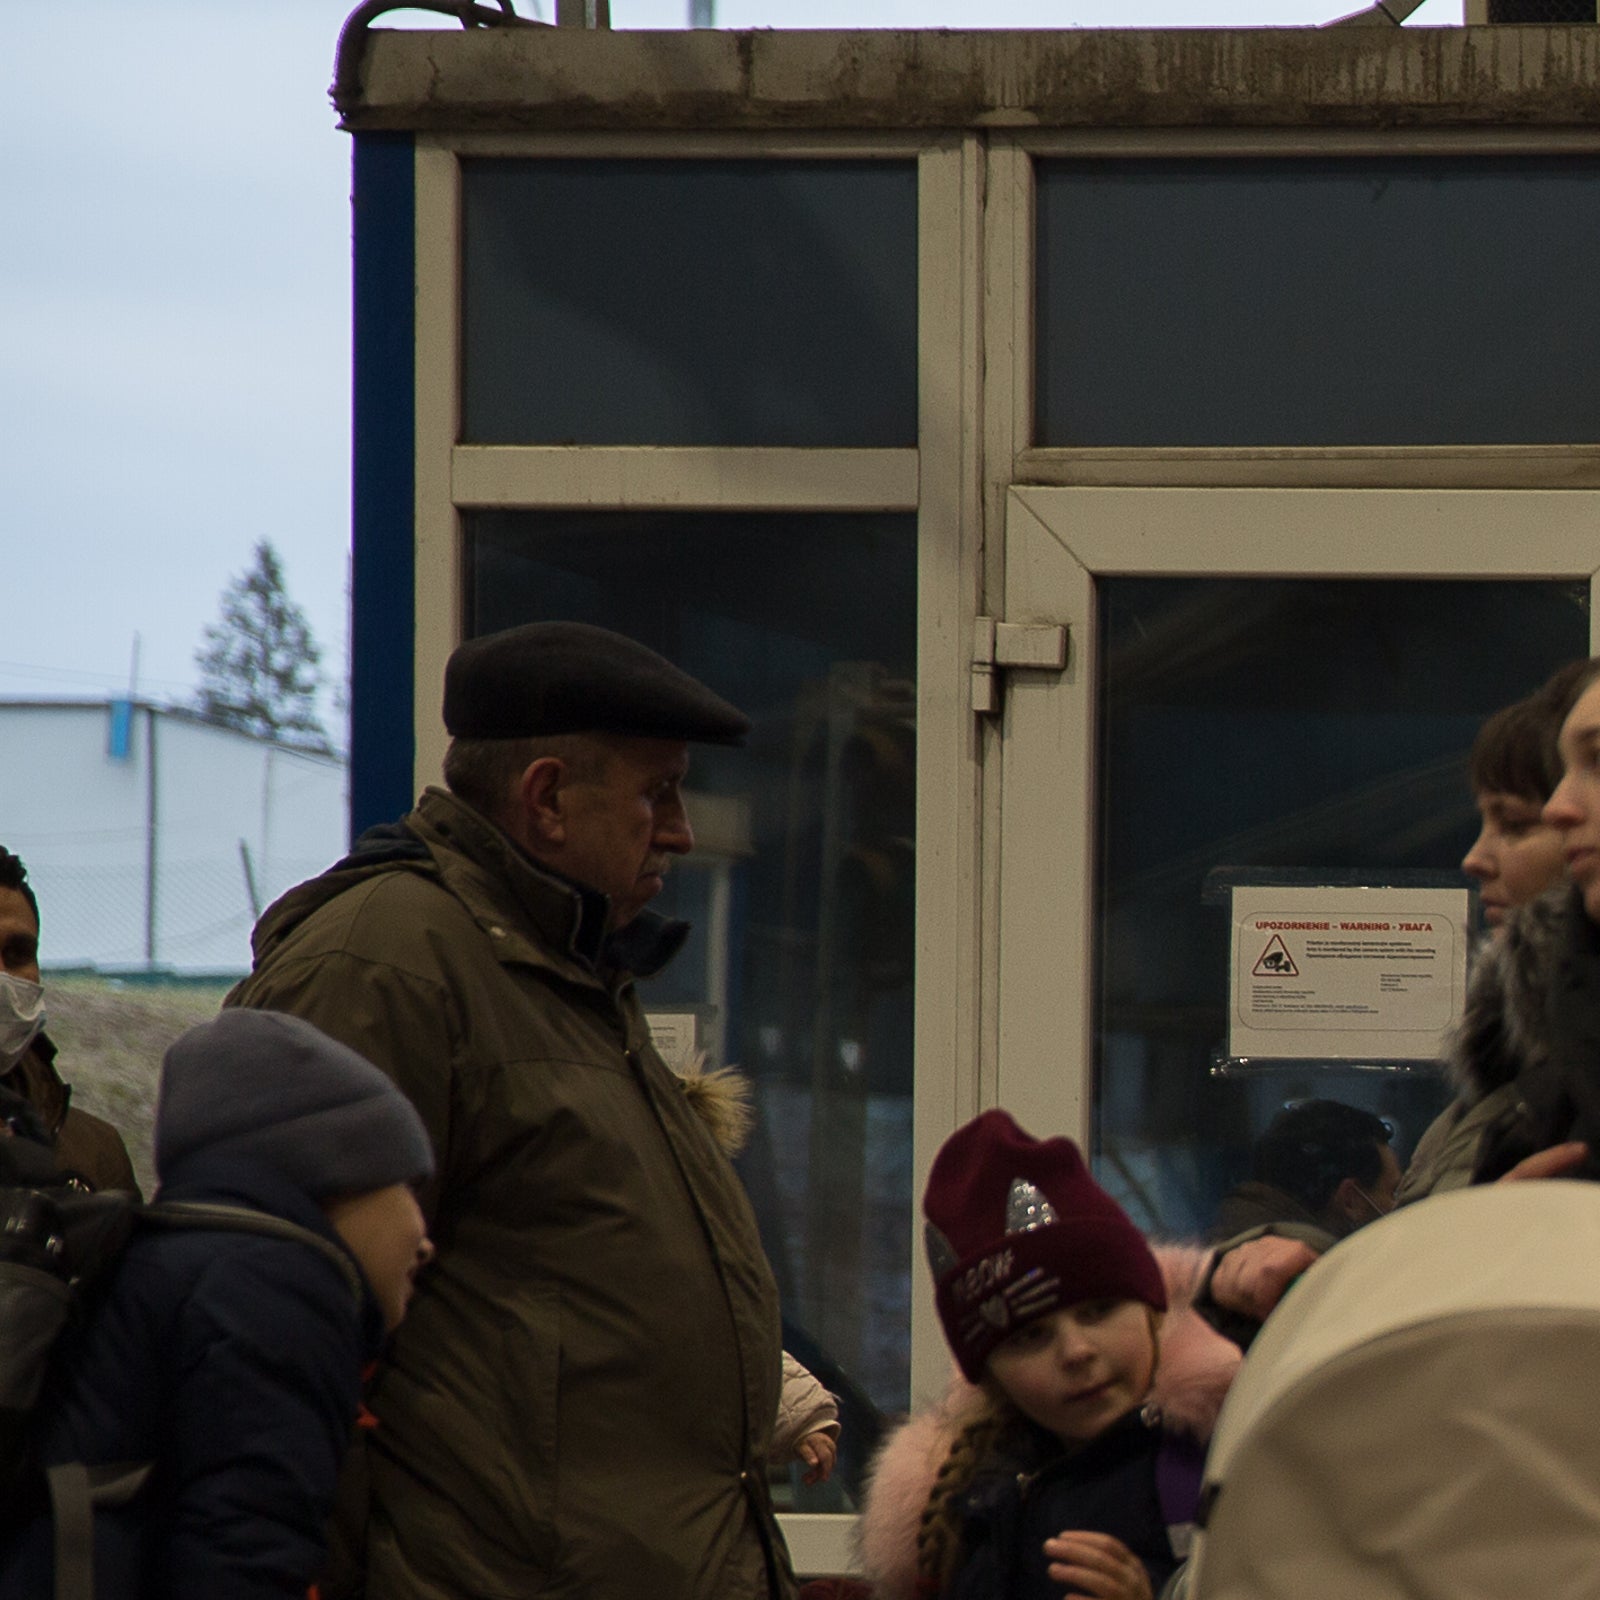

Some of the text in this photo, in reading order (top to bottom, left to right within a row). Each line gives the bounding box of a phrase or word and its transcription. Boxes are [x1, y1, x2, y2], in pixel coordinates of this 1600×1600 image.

[1255, 921, 1330, 931] UPOZORNENIE
[1340, 922, 1390, 931] WARNING
[1398, 923, 1432, 932] УВАГА
